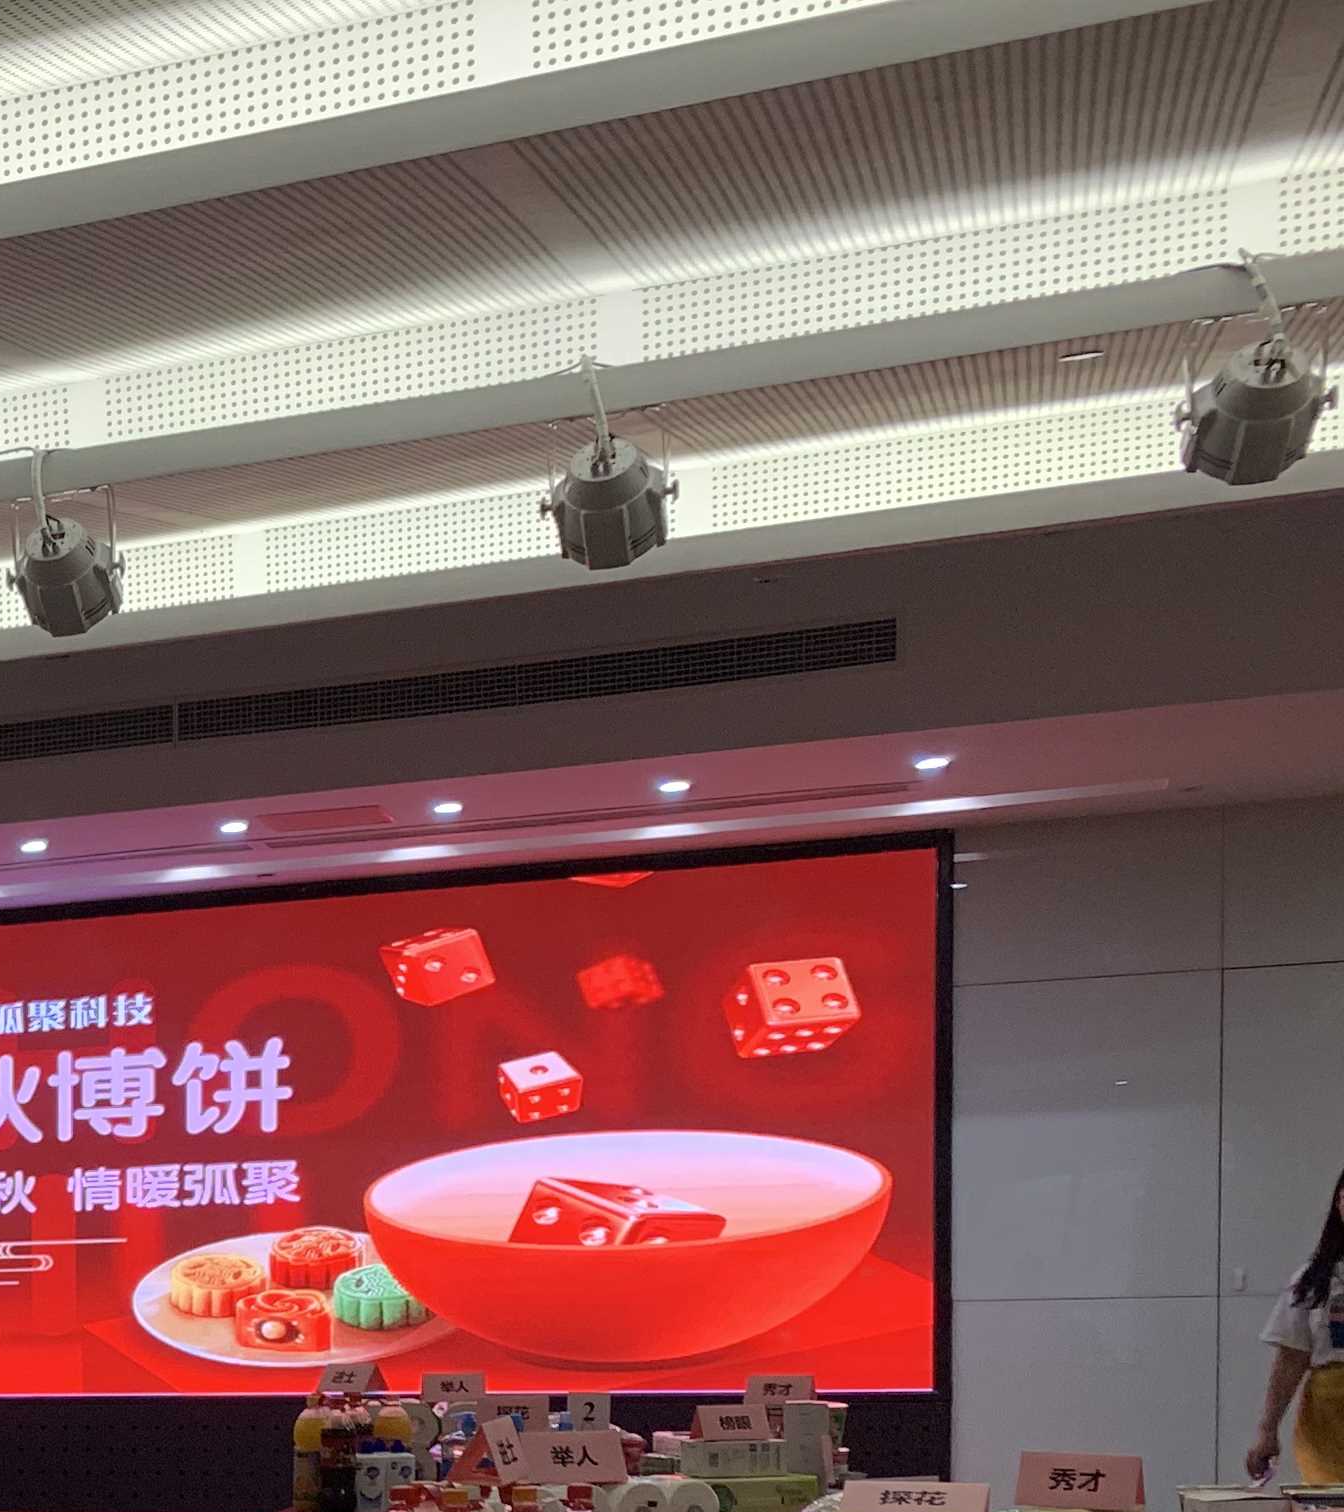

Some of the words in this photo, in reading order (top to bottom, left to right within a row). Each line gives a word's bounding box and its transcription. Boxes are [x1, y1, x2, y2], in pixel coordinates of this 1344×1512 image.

[67, 1160, 301, 1213] 情暖弧聚
[583, 1401, 595, 1421] 2
[550, 1445, 599, 1467] 举人
[1048, 1468, 1106, 1491] 秀才
